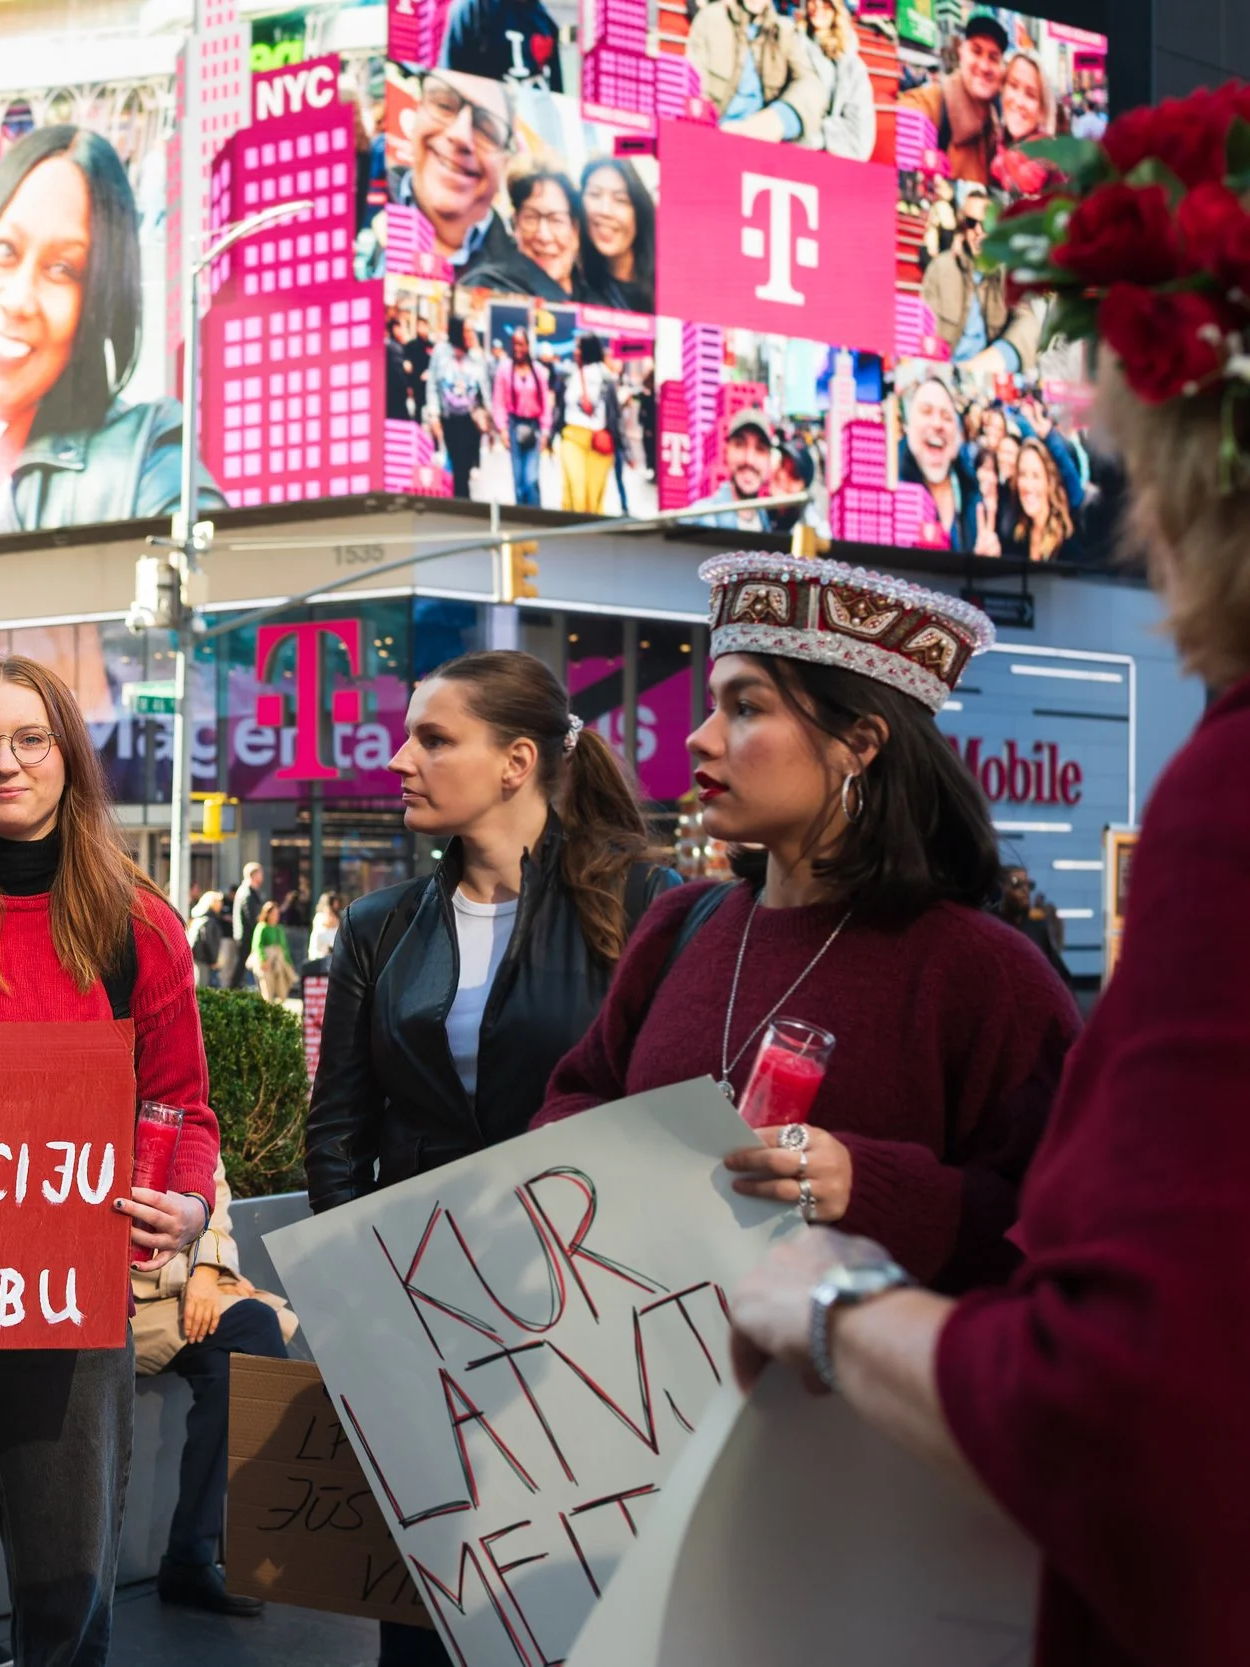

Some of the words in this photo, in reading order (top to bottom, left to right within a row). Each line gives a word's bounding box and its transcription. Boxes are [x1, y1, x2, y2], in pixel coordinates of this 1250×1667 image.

[256, 65, 334, 121] NYC
[741, 171, 819, 306] T
[331, 545, 385, 568] 1535
[256, 619, 360, 779] T
[372, 1165, 670, 1361] KUR
